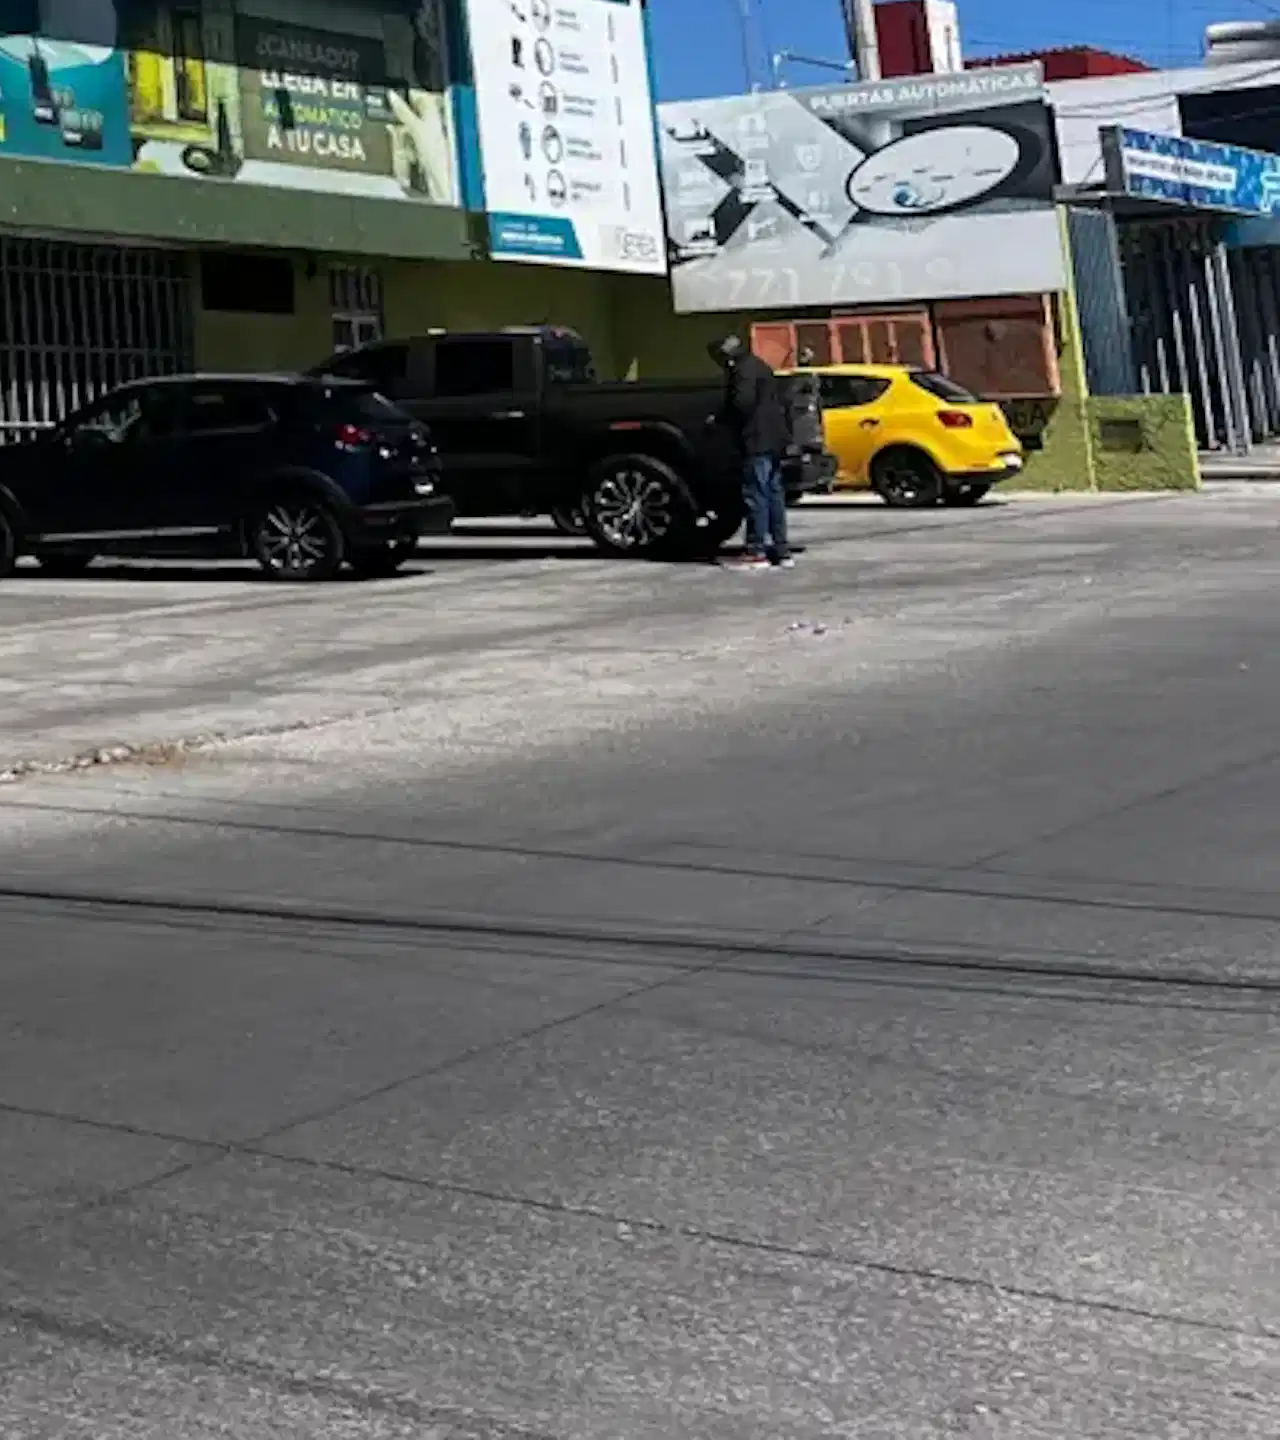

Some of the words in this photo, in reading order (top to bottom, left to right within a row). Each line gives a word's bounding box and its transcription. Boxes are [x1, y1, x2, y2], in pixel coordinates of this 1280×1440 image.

[810, 86, 895, 111] PUERTAS
[267, 124, 282, 149] A
[286, 129, 312, 154] TU
[313, 132, 367, 162] CASA
